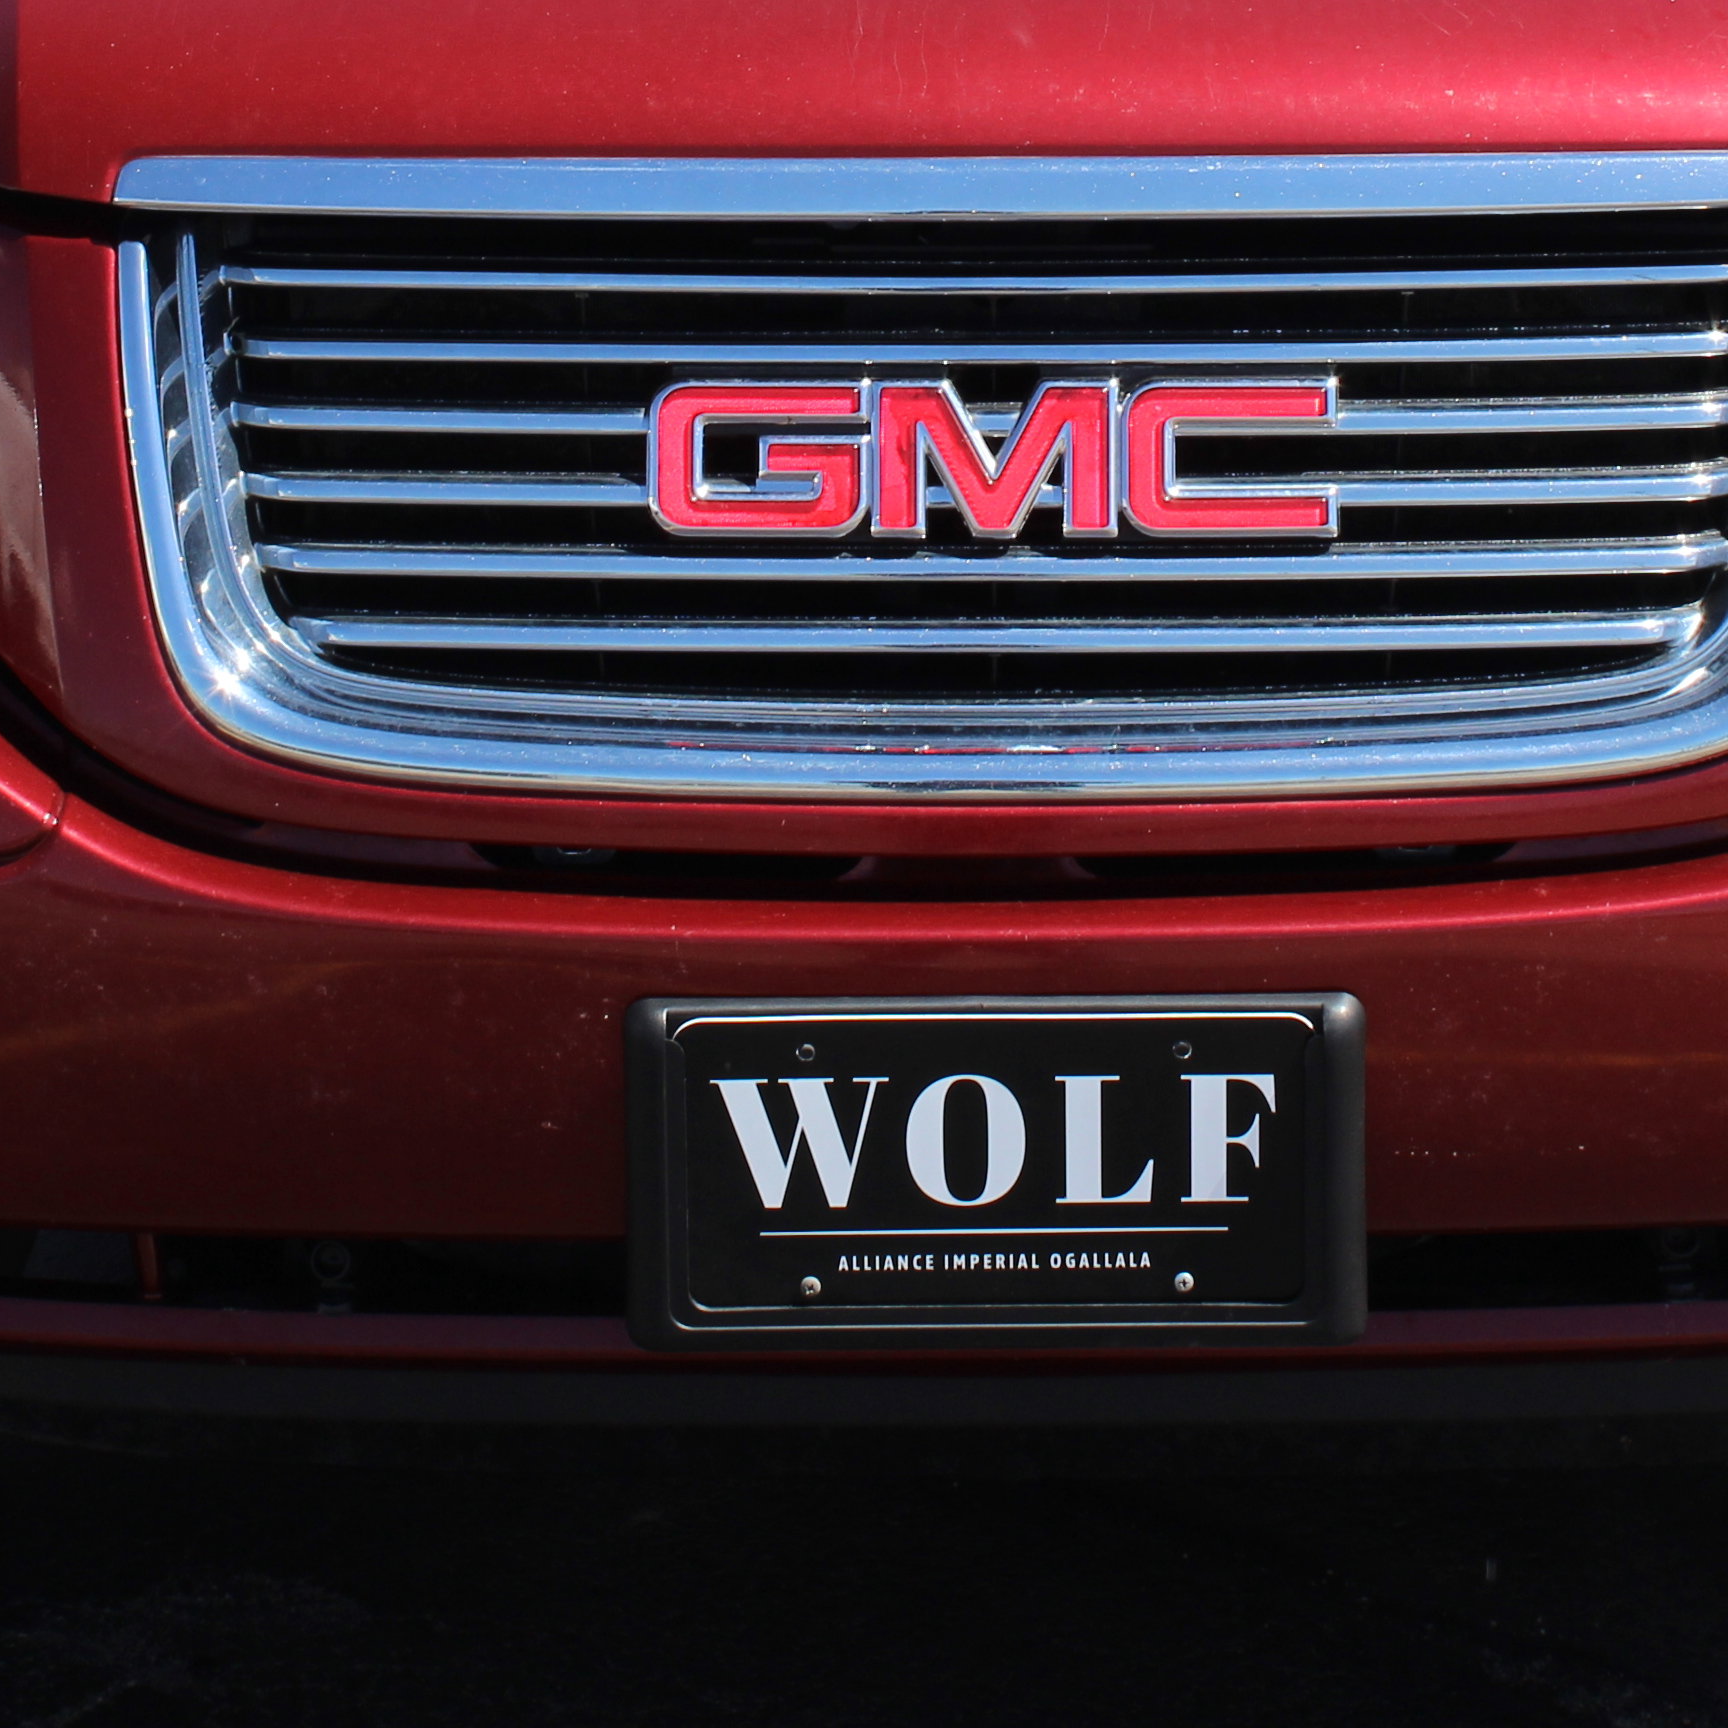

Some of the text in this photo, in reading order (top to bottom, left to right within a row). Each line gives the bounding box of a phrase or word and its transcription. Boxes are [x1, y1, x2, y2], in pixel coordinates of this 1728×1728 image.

[647, 375, 1340, 539] GMC
[709, 1074, 1276, 1209] WOLF
[838, 1251, 1151, 1271] ALLIANCE IMPERIAL OGALLALA
